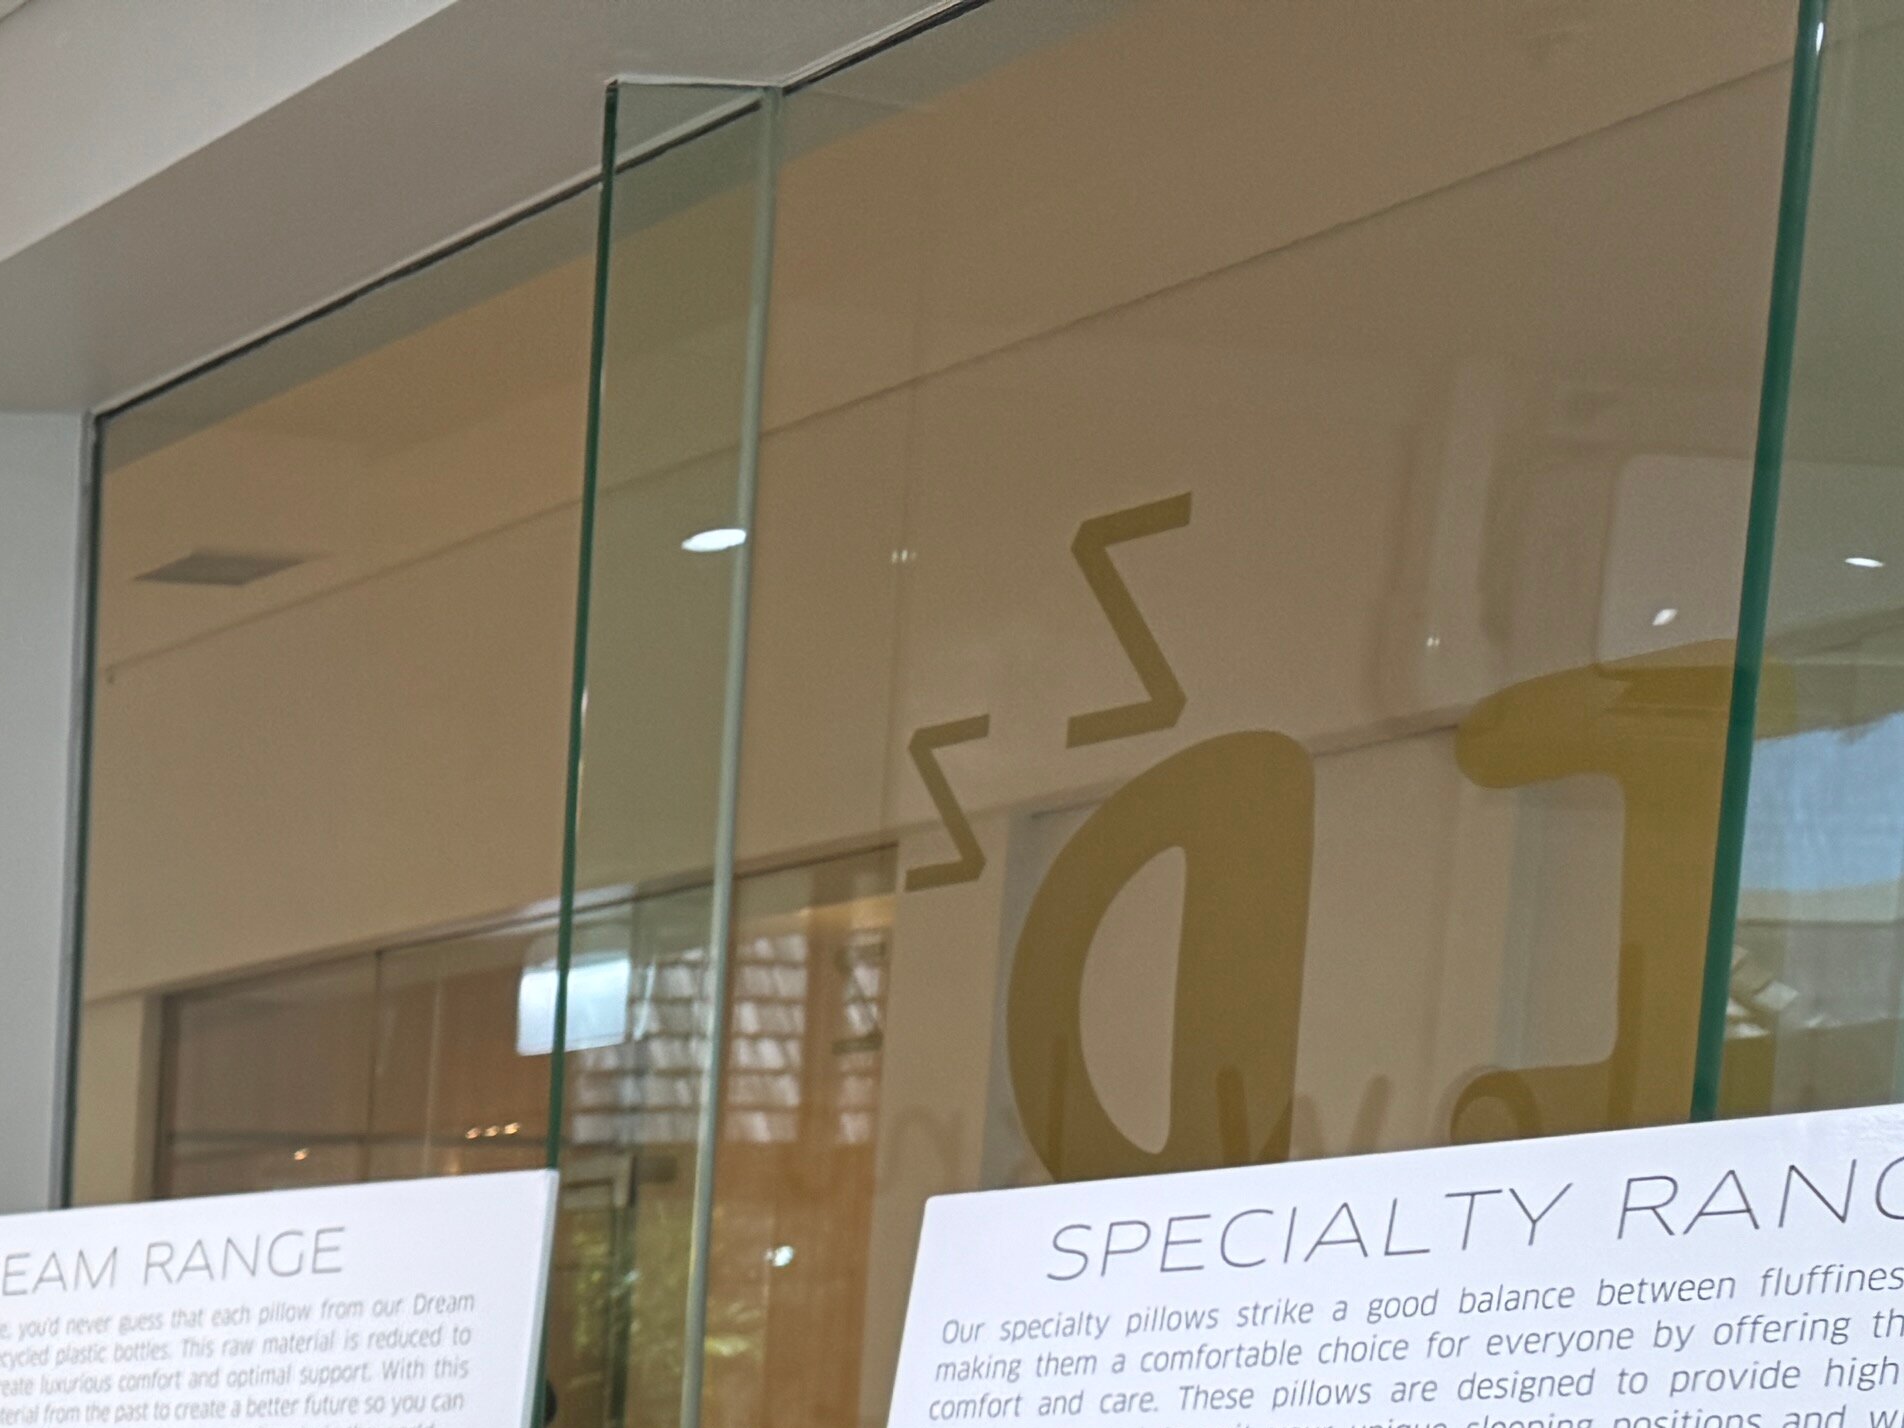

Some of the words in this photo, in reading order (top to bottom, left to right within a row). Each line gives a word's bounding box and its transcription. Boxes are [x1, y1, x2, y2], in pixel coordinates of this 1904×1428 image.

[142, 1224, 347, 1287] RANGE
[1045, 1181, 1574, 1283] SPECIALTY
[65, 1315, 112, 1334] never
[117, 1312, 163, 1335] guess
[170, 1307, 204, 1328] that
[210, 1304, 251, 1327] each
[257, 1301, 312, 1325] pillow
[320, 1298, 364, 1319] from
[371, 1297, 404, 1318] our
[412, 1292, 475, 1315] Dream
[941, 1318, 985, 1344] Our
[999, 1311, 1110, 1342] specialty
[1125, 1305, 1218, 1336] pillows
[1236, 1297, 1314, 1327] strike
[1331, 1299, 1348, 1322] a
[1366, 1288, 1439, 1324] good
[1458, 1284, 1575, 1314] balance
[1596, 1276, 1735, 1306] between
[40, 1375, 112, 1394] luxurious
[117, 1370, 182, 1392] comfort
[187, 1367, 220, 1389] and
[226, 1364, 291, 1388] optimal
[299, 1362, 371, 1385] support.
[381, 1359, 425, 1381] With
[433, 1356, 469, 1379] this
[54, 1344, 106, 1366] plastic
[112, 1342, 170, 1362] bottles.
[181, 1337, 214, 1358] This
[221, 1338, 255, 1356] raw
[262, 1330, 335, 1354] material
[343, 1329, 359, 1351] is
[367, 1325, 442, 1349] reduced
[451, 1325, 472, 1346] to
[935, 1354, 1021, 1383] making
[1035, 1351, 1097, 1377] them
[1110, 1352, 1126, 1374] a
[1140, 1340, 1301, 1372] comfortable
[1317, 1334, 1409, 1364] choice
[1426, 1330, 1470, 1359] for
[1486, 1327, 1634, 1357] everyone
[1652, 1319, 1695, 1352] by
[1713, 1312, 1850, 1345] offering
[43, 1403, 80, 1423] from
[84, 1403, 111, 1422] the
[113, 1402, 149, 1423] past
[173, 1400, 226, 1420] create
[245, 1397, 299, 1418] better
[303, 1394, 359, 1416] future
[364, 1394, 386, 1414] so
[390, 1394, 426, 1416] you
[430, 1392, 465, 1412] can
[928, 1392, 1022, 1421] comfort
[1037, 1389, 1084, 1416] and
[1098, 1391, 1158, 1414] care.
[1179, 1384, 1254, 1410] These
[1271, 1379, 1371, 1411] pillows
[1390, 1379, 1438, 1403] are
[1457, 1368, 1595, 1403] designed
[1616, 1367, 1648, 1395] to
[1669, 1360, 1800, 1396] provide
